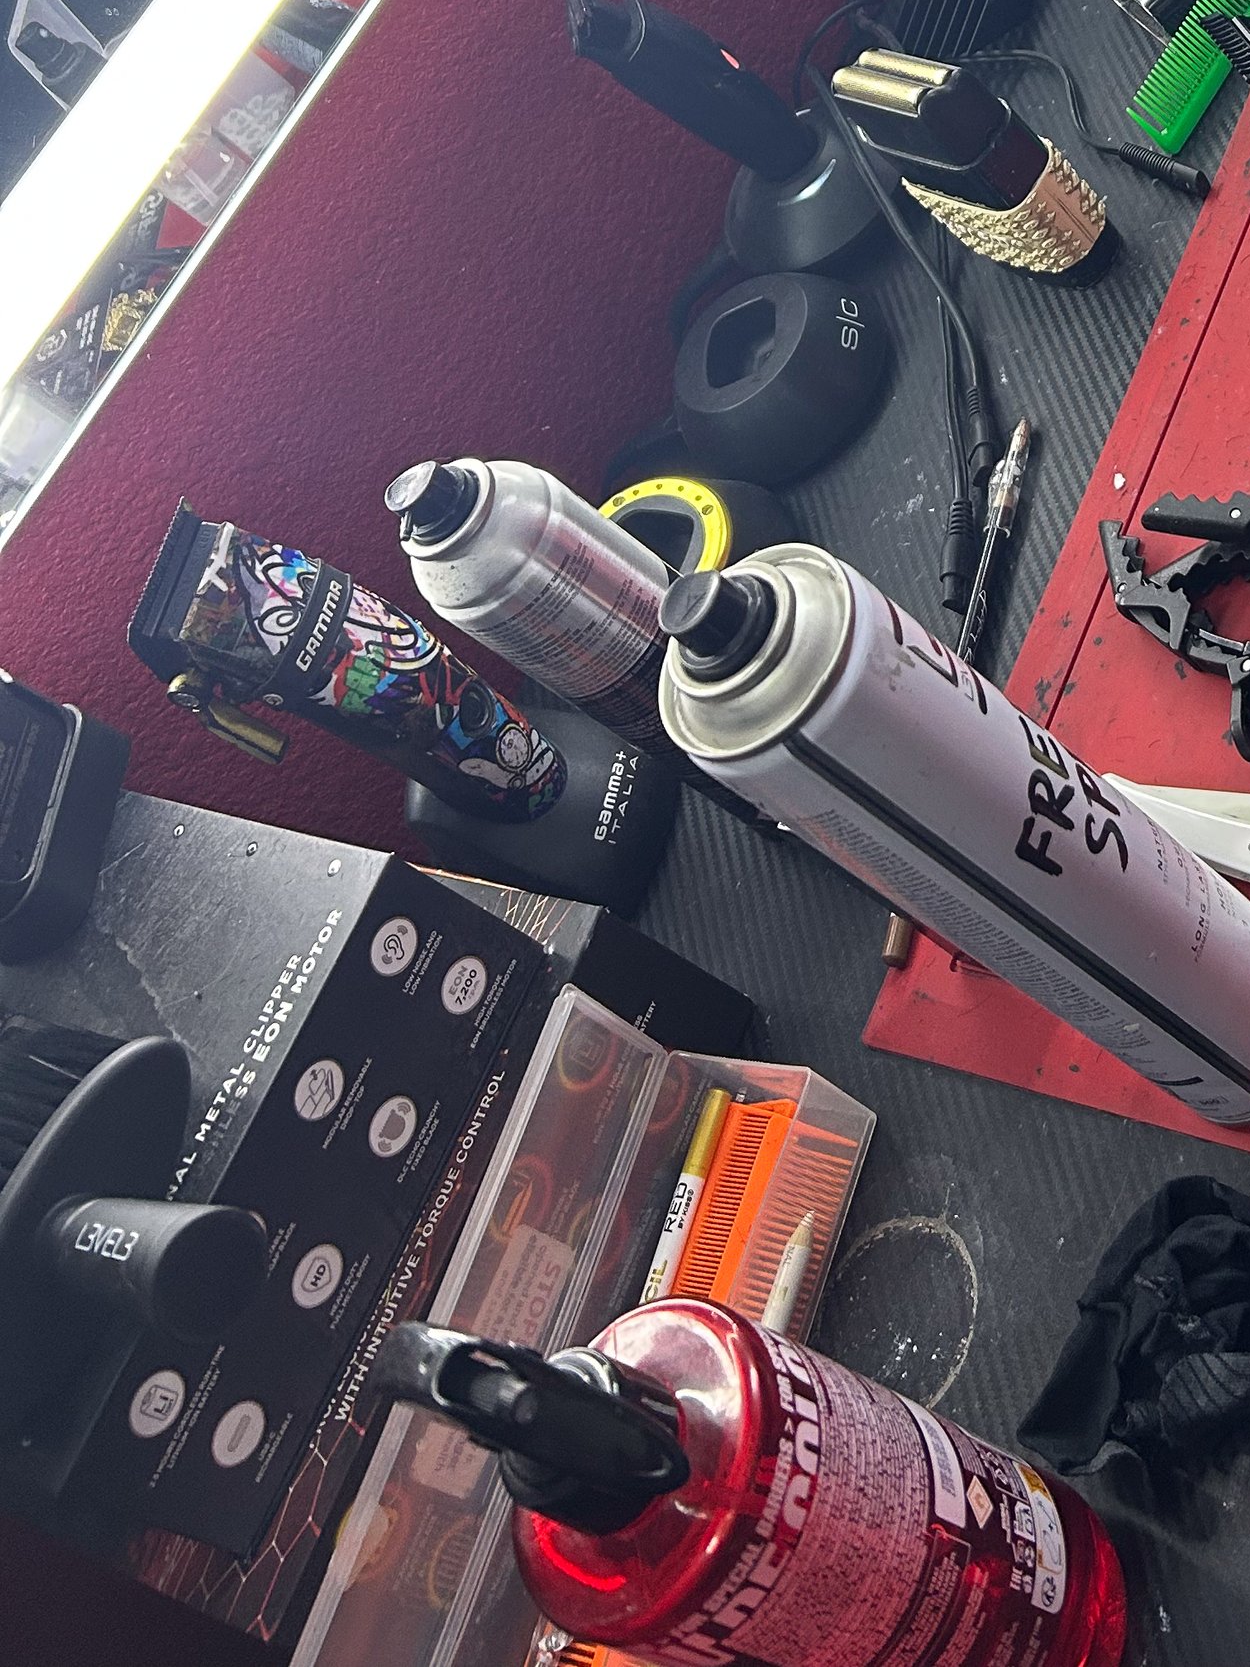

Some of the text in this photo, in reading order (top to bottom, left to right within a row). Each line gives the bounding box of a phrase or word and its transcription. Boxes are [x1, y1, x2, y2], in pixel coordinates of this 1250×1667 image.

[293, 578, 344, 672] GAMMA
[607, 752, 640, 845] ITALIA
[1190, 901, 1207, 953] LONG
[252, 995, 296, 1064] EON
[289, 906, 344, 997] MOTOR
[401, 929, 438, 993] LOW NOISE AND
[408, 933, 445, 996] LOW VIBRATION
[447, 964, 468, 996] EON
[454, 968, 480, 1007] 7,200
[472, 973, 504, 1026] HIGH TORQUE
[478, 986, 505, 1032] BRUSHLESS
[500, 958, 519, 988] MOTOR
[193, 1059, 246, 1144] METAL
[240, 951, 304, 1055] CLIPPER
[320, 1104, 348, 1150] MODULAR
[408, 1116, 441, 1171] FIXED BLADE
[418, 1099, 443, 1142] CRUNCHY
[663, 1181, 688, 1234] RED
[677, 1215, 686, 1229] BY
[333, 1359, 373, 1424] WITH
[362, 1251, 422, 1362] INTUITIVE
[413, 1165, 462, 1254] TORQUE
[453, 1067, 508, 1166] CONTROL
[309, 1261, 329, 1288] HD
[339, 1277, 359, 1309] METAL
[172, 1389, 203, 1441] CORDLESS
[253, 1411, 295, 1483] RECHARGEABLE
